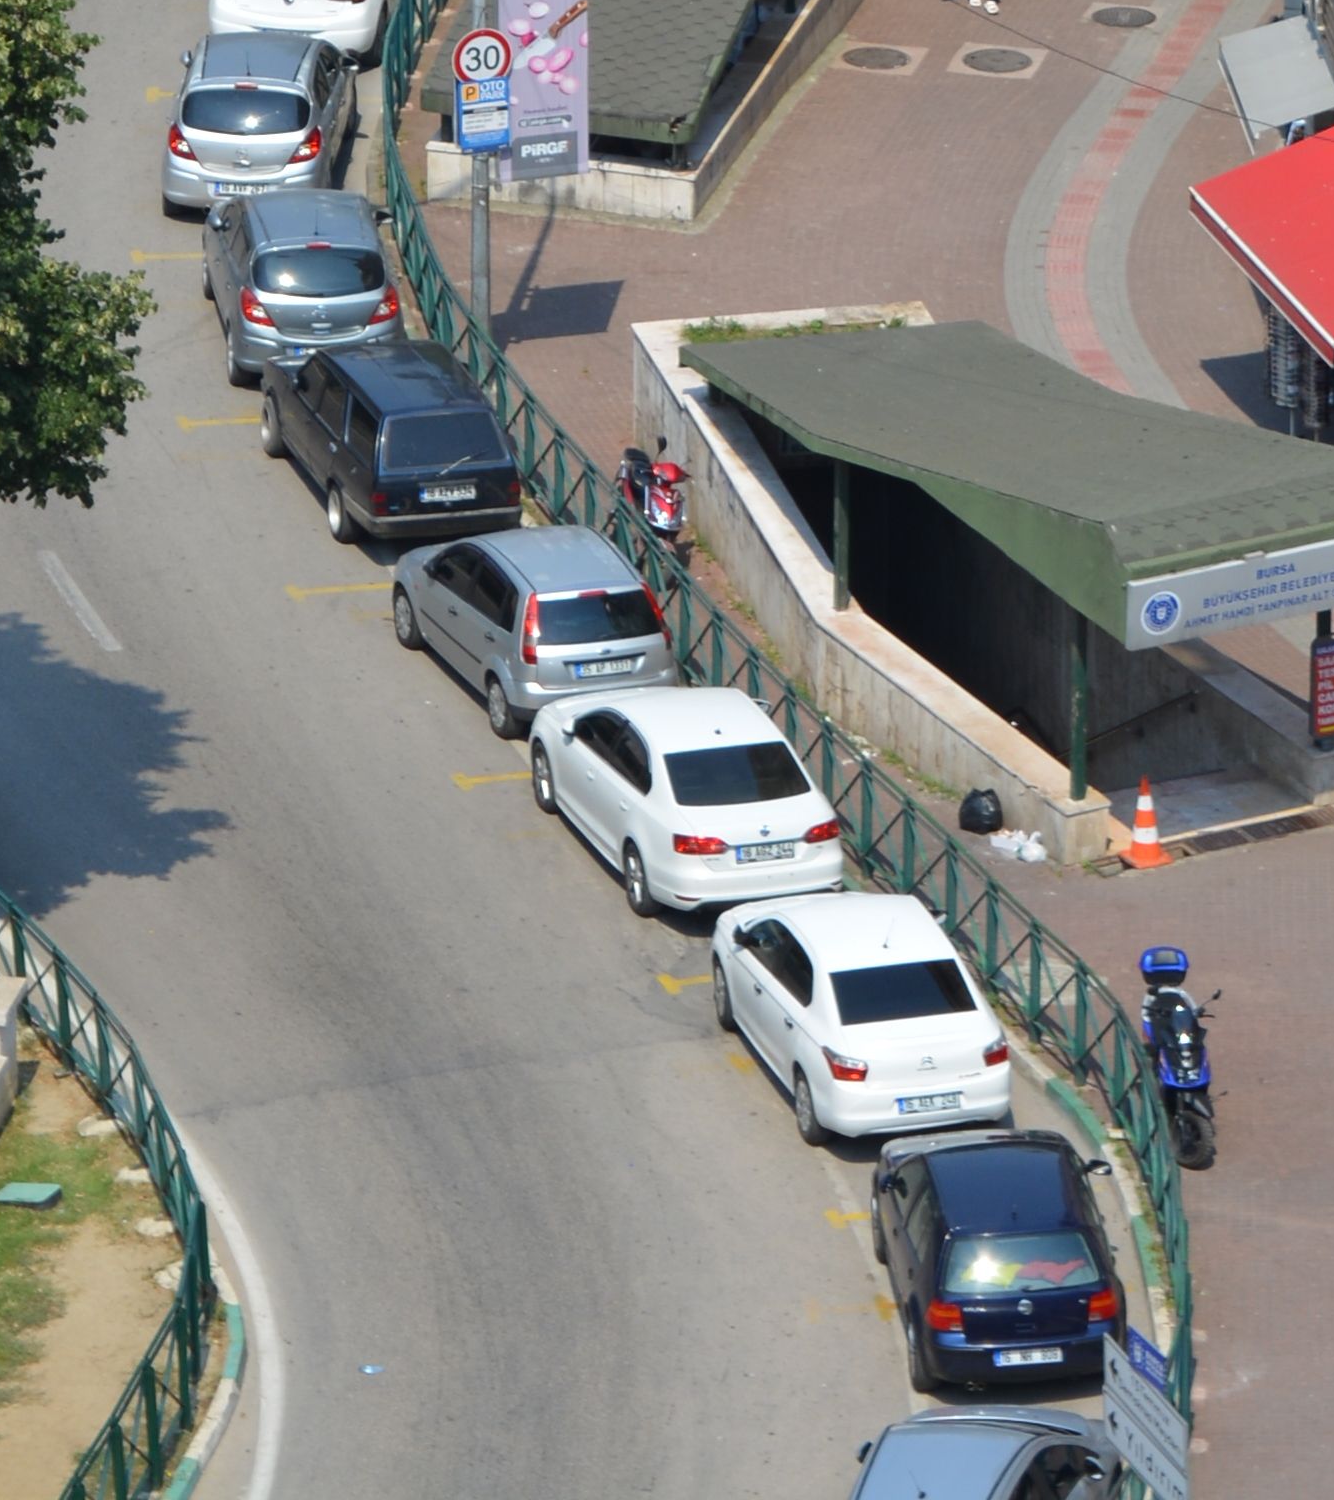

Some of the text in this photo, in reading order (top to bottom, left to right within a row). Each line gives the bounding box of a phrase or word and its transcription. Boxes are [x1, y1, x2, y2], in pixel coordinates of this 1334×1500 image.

[465, 45, 500, 72] 30
[480, 80, 506, 91] OTO
[480, 89, 506, 100] PARK
[1256, 563, 1296, 580] BURSA
[1183, 613, 1219, 629] AHMET
[1257, 595, 1307, 614] TANPINAR
[1309, 590, 1330, 603] ALT
